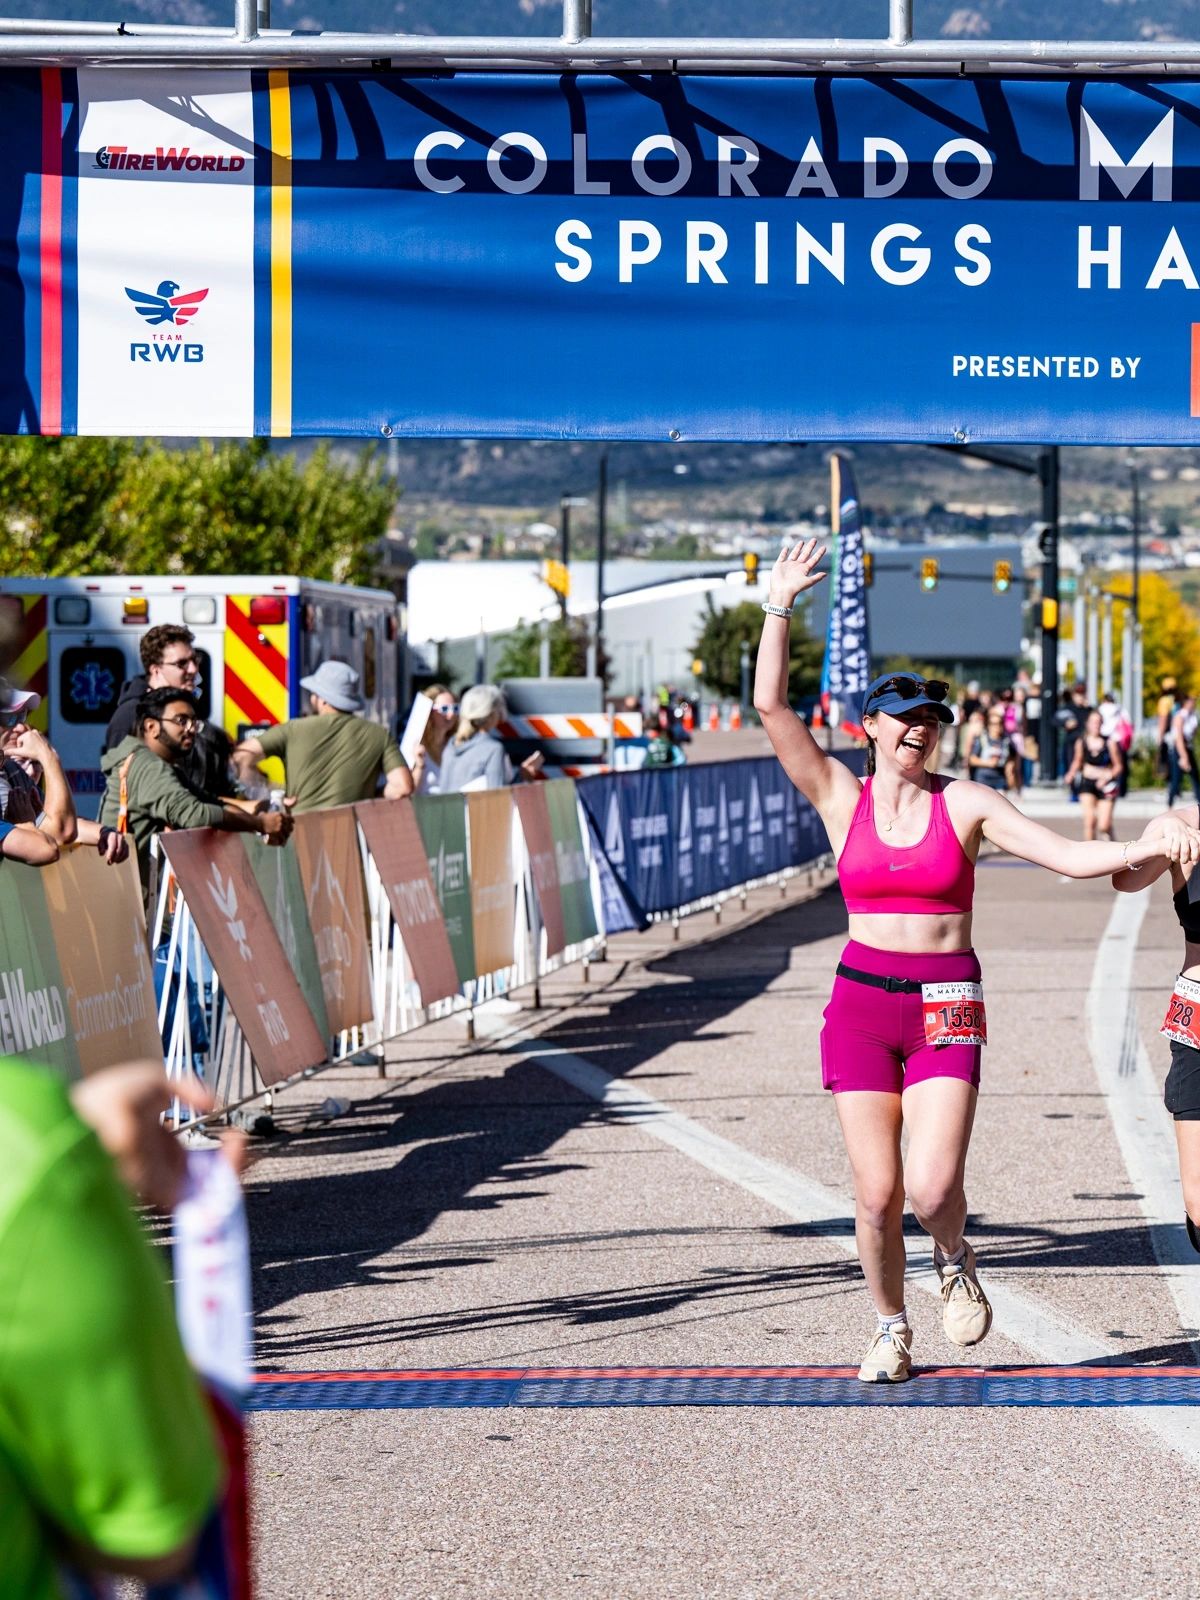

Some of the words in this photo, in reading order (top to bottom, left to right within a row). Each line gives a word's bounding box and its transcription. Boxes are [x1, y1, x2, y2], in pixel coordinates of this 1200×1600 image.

[414, 131, 993, 199] COLORADO
[555, 219, 991, 287] SPRINGS
[130, 343, 204, 363] RWB
[952, 355, 1099, 379] PRESENTED
[1111, 357, 1141, 379] BY
[0, 968, 66, 1056] EWORLD
[939, 1007, 981, 1028] 1558
